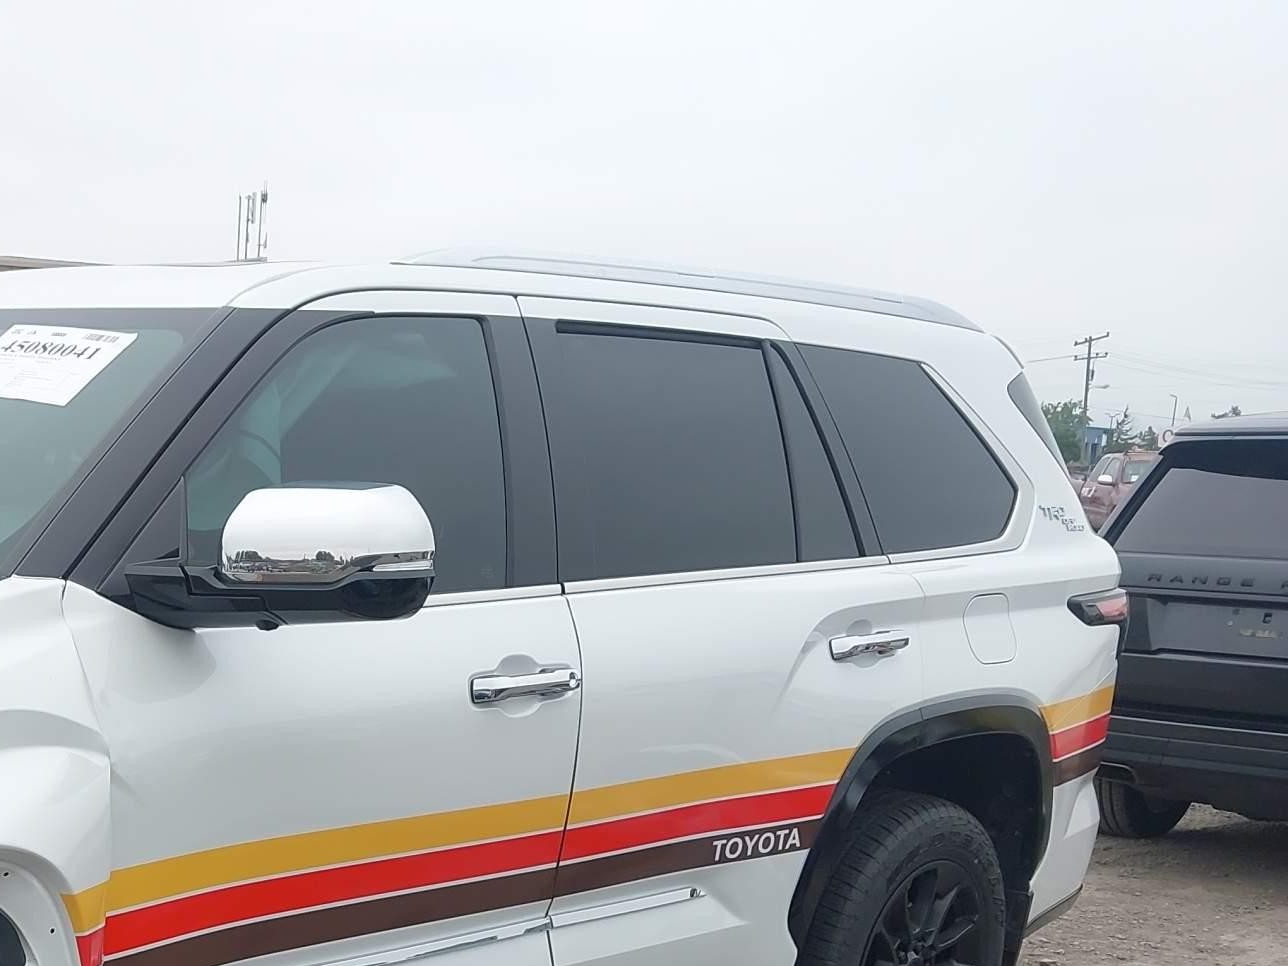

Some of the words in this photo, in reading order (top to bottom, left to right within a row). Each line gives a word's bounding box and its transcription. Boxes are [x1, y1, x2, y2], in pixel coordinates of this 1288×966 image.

[1, 340, 101, 359] 45080041
[1146, 572, 1255, 588] RANGE
[712, 827, 801, 861] TOYOTA
